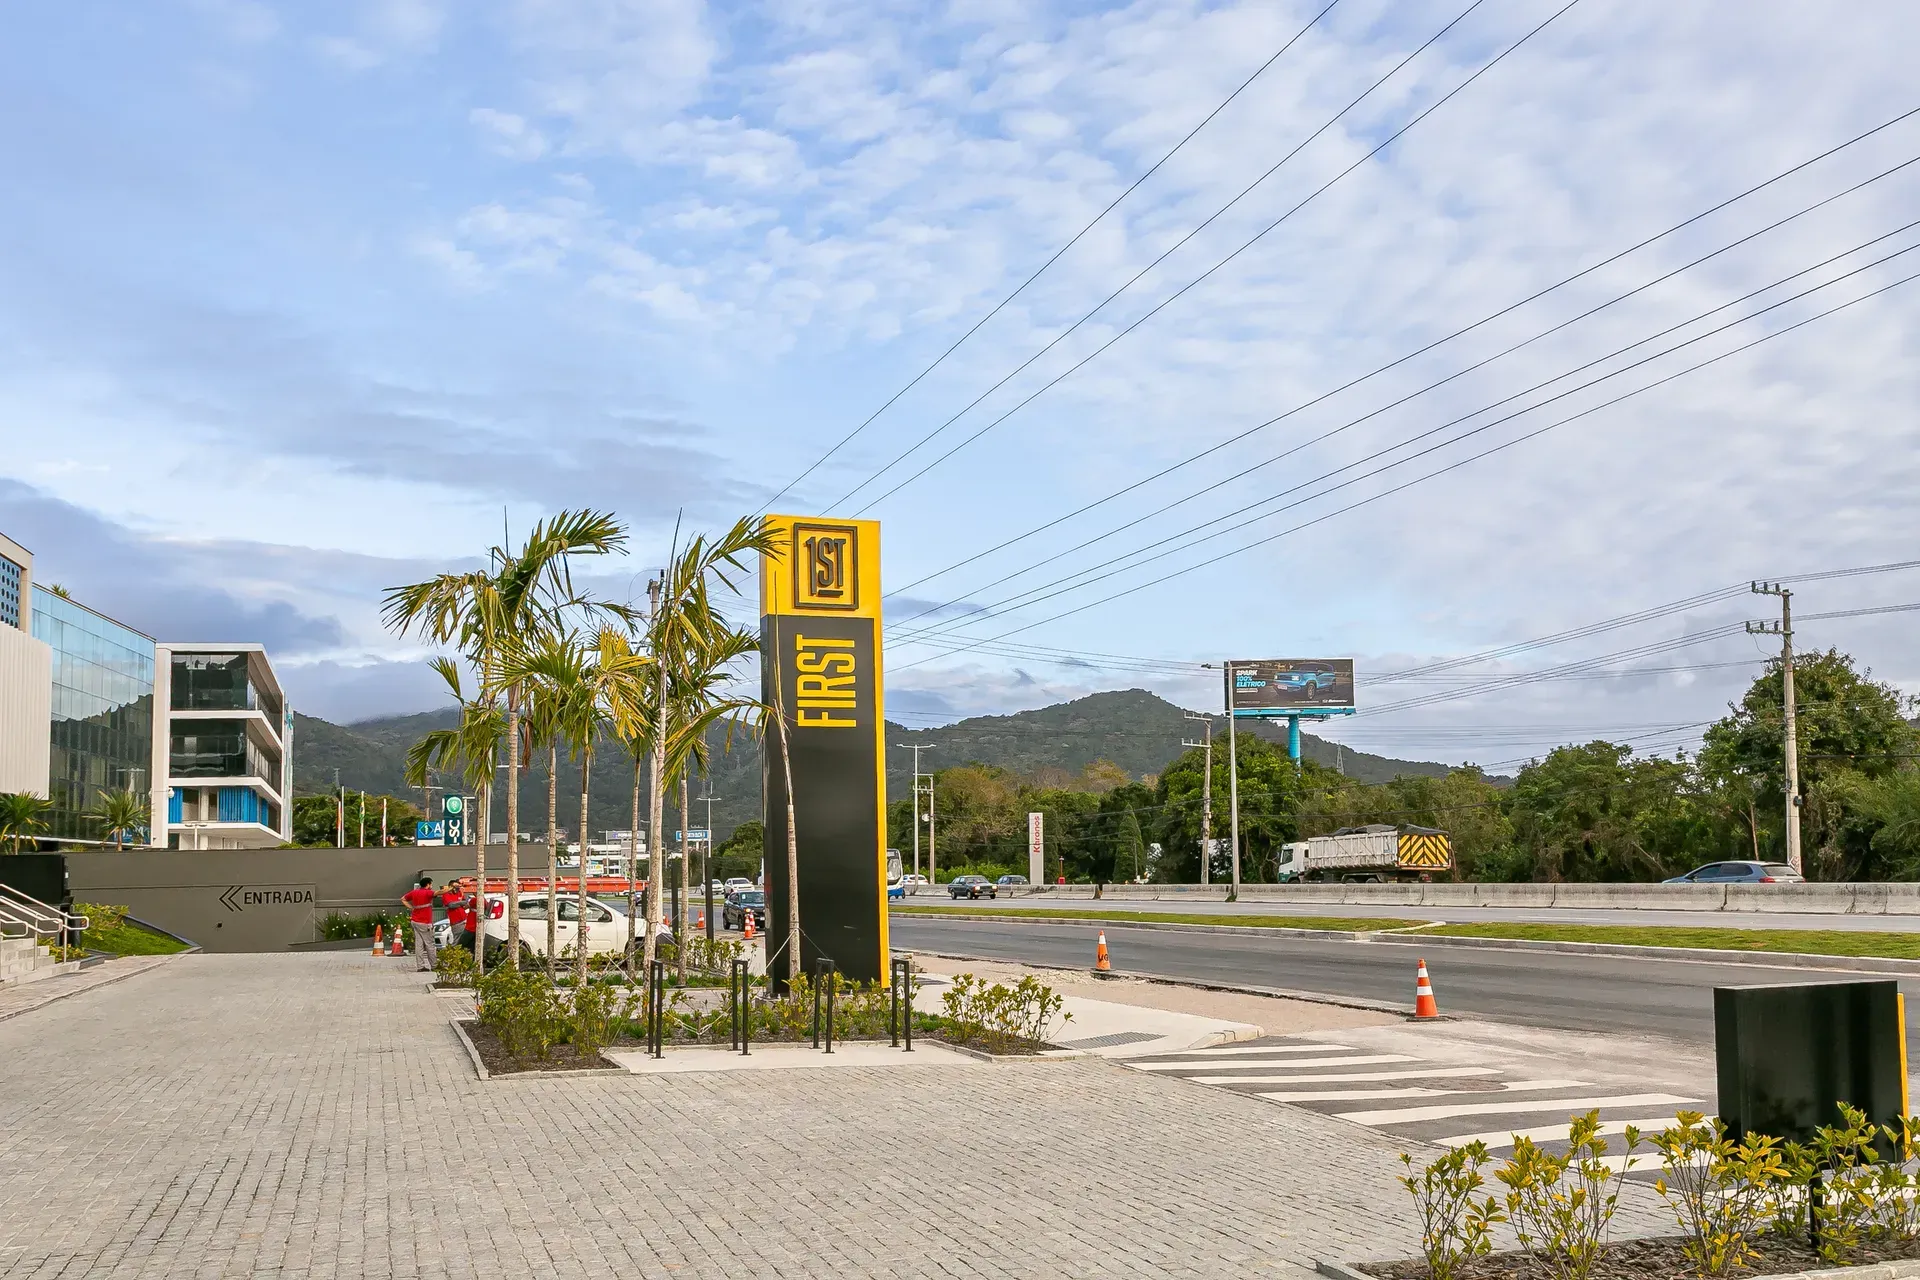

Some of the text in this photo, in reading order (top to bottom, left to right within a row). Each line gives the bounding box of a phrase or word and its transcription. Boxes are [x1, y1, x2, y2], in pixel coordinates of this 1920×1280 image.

[806, 536, 847, 598] 1ST
[795, 634, 857, 728] FIRST
[243, 890, 314, 904] ENTRADA
